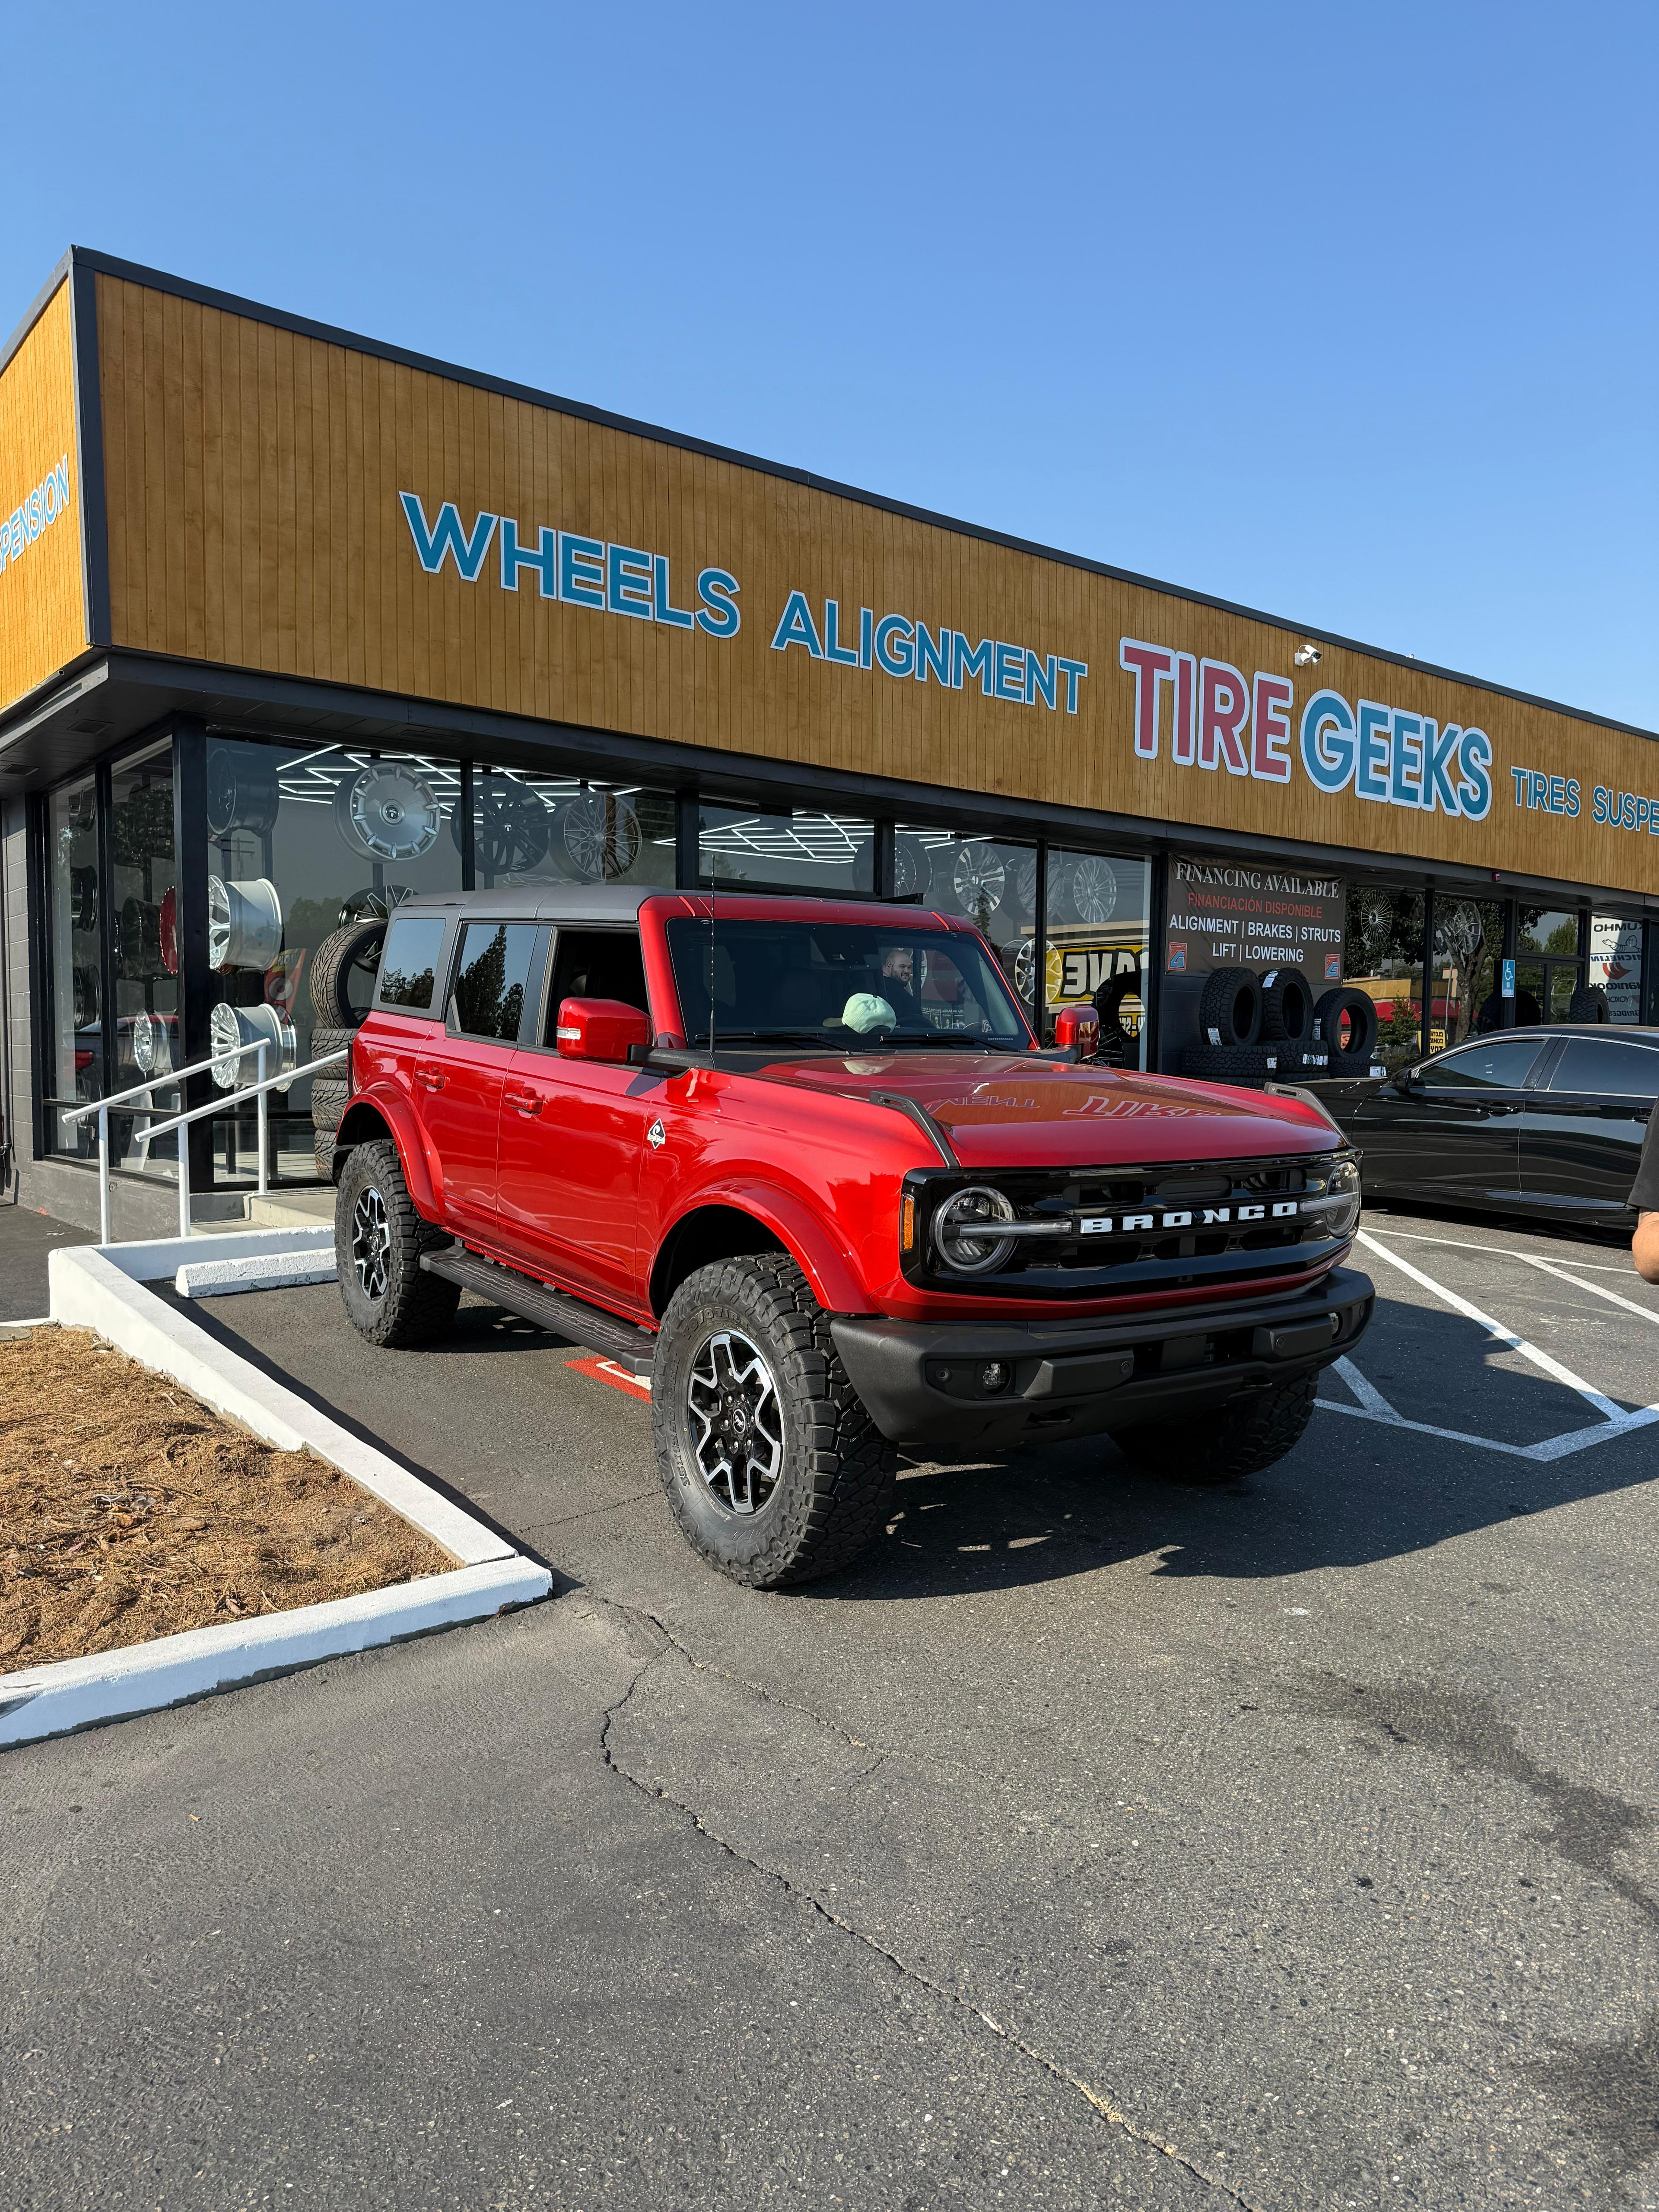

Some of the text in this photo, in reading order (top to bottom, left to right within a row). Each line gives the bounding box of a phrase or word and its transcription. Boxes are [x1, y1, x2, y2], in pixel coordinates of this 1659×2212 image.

[0, 452, 70, 576] PENSION
[398, 490, 1088, 715] WHEELS ALIGNMENT
[1120, 637, 1493, 821] TIRE GEEKS
[1511, 766, 1580, 818] TIRES
[1176, 862, 1339, 898] FINANCING AVAILABLE
[1188, 893, 1322, 918] FINANCIACIÓN DISPONIBLE
[1169, 914, 1341, 943] ALIGNMENT BRAKES STRUTS
[1212, 942, 1304, 963] LIFT LOWERING
[1081, 1202, 1297, 1233] BRONCO
[682, 1307, 714, 1340] TOYO
